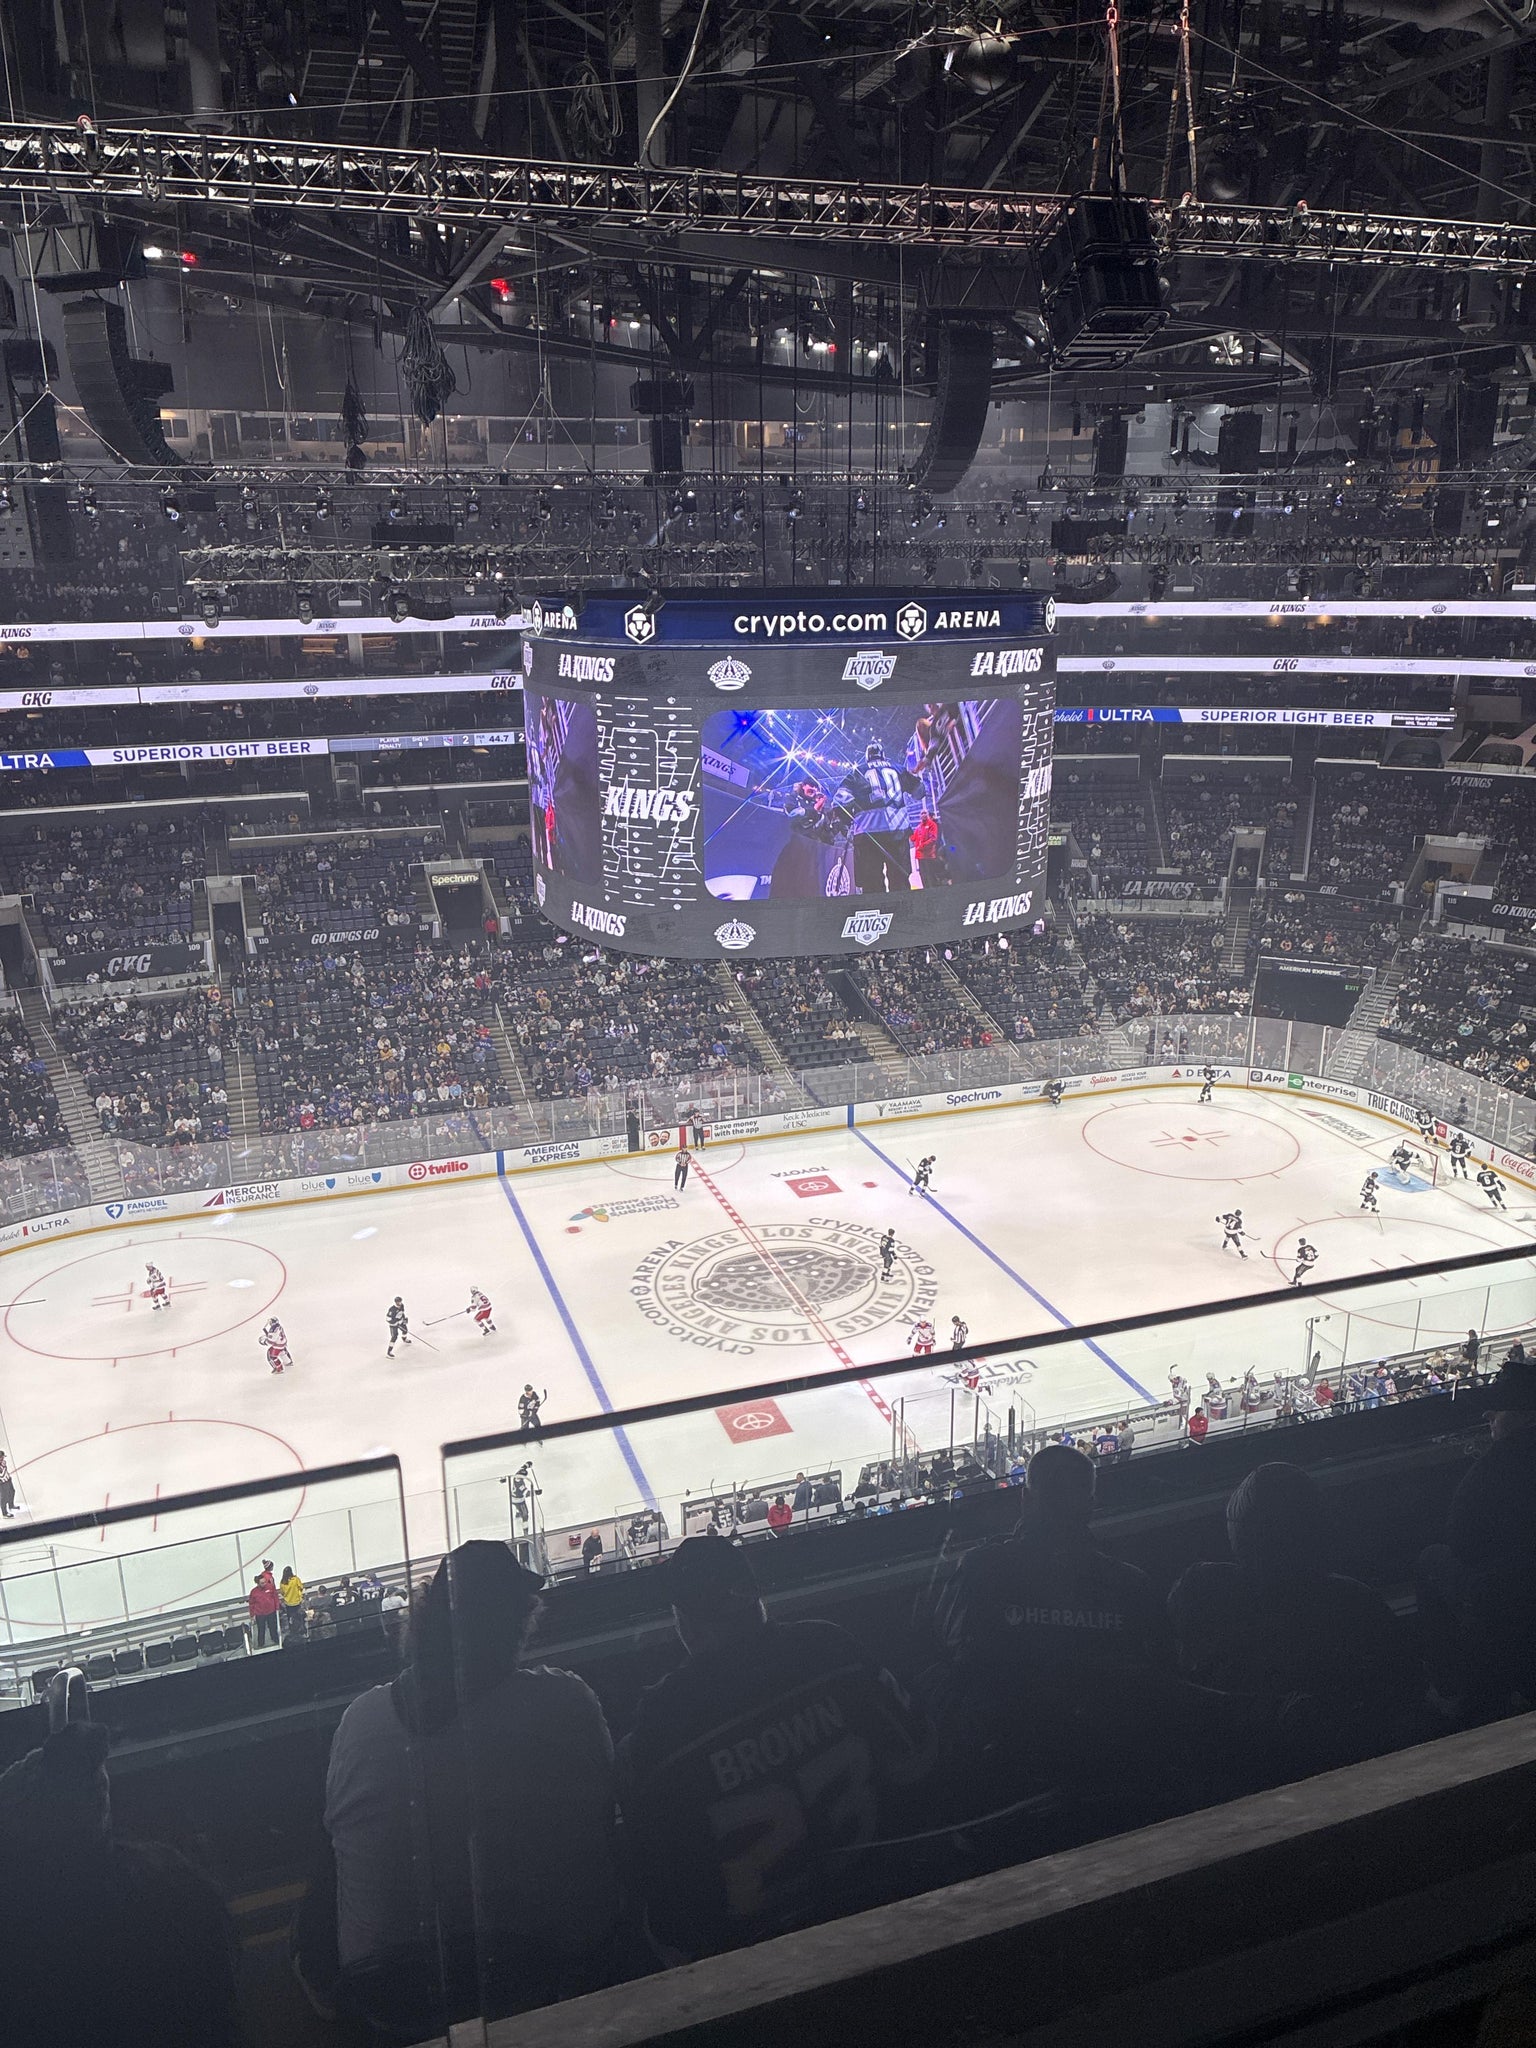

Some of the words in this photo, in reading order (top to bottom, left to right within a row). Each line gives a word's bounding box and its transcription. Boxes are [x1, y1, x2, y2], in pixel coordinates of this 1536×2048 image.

[1270, 604, 1281, 613] LA
[1281, 604, 1306, 613] KINGS
[470, 618, 482, 627] LA
[482, 617, 506, 628] KINGS
[544, 611, 577, 630] ARENA
[734, 611, 887, 636] crypto.com
[934, 610, 1001, 629] ARENA
[1, 627, 32, 639] KINGS
[559, 654, 572, 678] LA
[572, 655, 616, 682] KINGS
[849, 660, 892, 676] KINGS
[970, 652, 994, 677] LA
[994, 648, 1044, 678] KINGS
[1273, 658, 1298, 671] GKG
[491, 675, 516, 690] GKG
[22, 691, 52, 706] GKG
[1099, 708, 1154, 721] ULTRA
[1201, 709, 1276, 722] SUPERIOR
[1283, 711, 1327, 724] LIGHT
[1333, 713, 1375, 725] BEER
[463, 735, 469, 744] 2
[489, 734, 509, 743] 44.7
[113, 746, 203, 763] SUPERIOR
[210, 743, 260, 757] LIGHT
[267, 741, 311, 755] BEER
[702, 753, 736, 776] KINGS
[865, 767, 902, 803] 10
[604, 785, 694, 822] KINGS
[432, 873, 475, 887] Spectrum
[1122, 881, 1142, 896] LA
[1319, 885, 1338, 896] GKG
[963, 902, 985, 926] LA
[986, 891, 1034, 924] KINGS
[1491, 904, 1508, 915] GO
[1508, 905, 1536, 919] KING
[572, 901, 585, 923] LA
[584, 908, 627, 937] KINGS
[849, 917, 889, 934] KINGS
[311, 932, 328, 945] GO
[329, 929, 362, 944] KINGS
[363, 928, 380, 941] GO
[52, 958, 66, 967] 109
[1279, 965, 1311, 975] AMERICAN
[1312, 968, 1342, 978] EXPRESS
[1186, 1068, 1231, 1079] DETA
[1293, 1078, 1357, 1098] enterprise
[946, 1090, 998, 1106] Spectrum
[1368, 1092, 1389, 1112] TRUE
[801, 1110, 831, 1120] Medicine
[714, 1122, 733, 1131] Save
[733, 1120, 758, 1131] money
[714, 1129, 730, 1138] with
[732, 1128, 744, 1137] the
[746, 1126, 760, 1136] app
[791, 1120, 808, 1129] USC
[523, 1141, 579, 1156] AMERICAN
[531, 1150, 580, 1164] EXPRESS
[428, 1161, 469, 1175] twilio
[770, 1166, 829, 1178] TOYOTA
[301, 1181, 325, 1190] blue
[347, 1174, 371, 1185] blue
[225, 1183, 279, 1197] MERCURY
[127, 1199, 168, 1210] FANDUEL
[226, 1191, 281, 1205] INSURANCE
[611, 1197, 676, 1213] Hospital
[609, 1202, 680, 1217] Children's
[31, 1217, 72, 1233] ULTRA
[669, 1233, 740, 1270] KINGS
[632, 1239, 686, 1284] ARENA
[808, 1216, 925, 1265] cryptocom
[896, 1277, 938, 1327] ARENA
[760, 1227, 814, 1239] LOS
[835, 1291, 906, 1334] KINGS
[662, 1274, 742, 1335] ANGELES
[635, 1297, 755, 1356] crypto.com
[750, 1327, 812, 1342] LOS
[1025, 1607, 1126, 1629] HERBALIFE
[709, 1695, 845, 1793] BROWN
